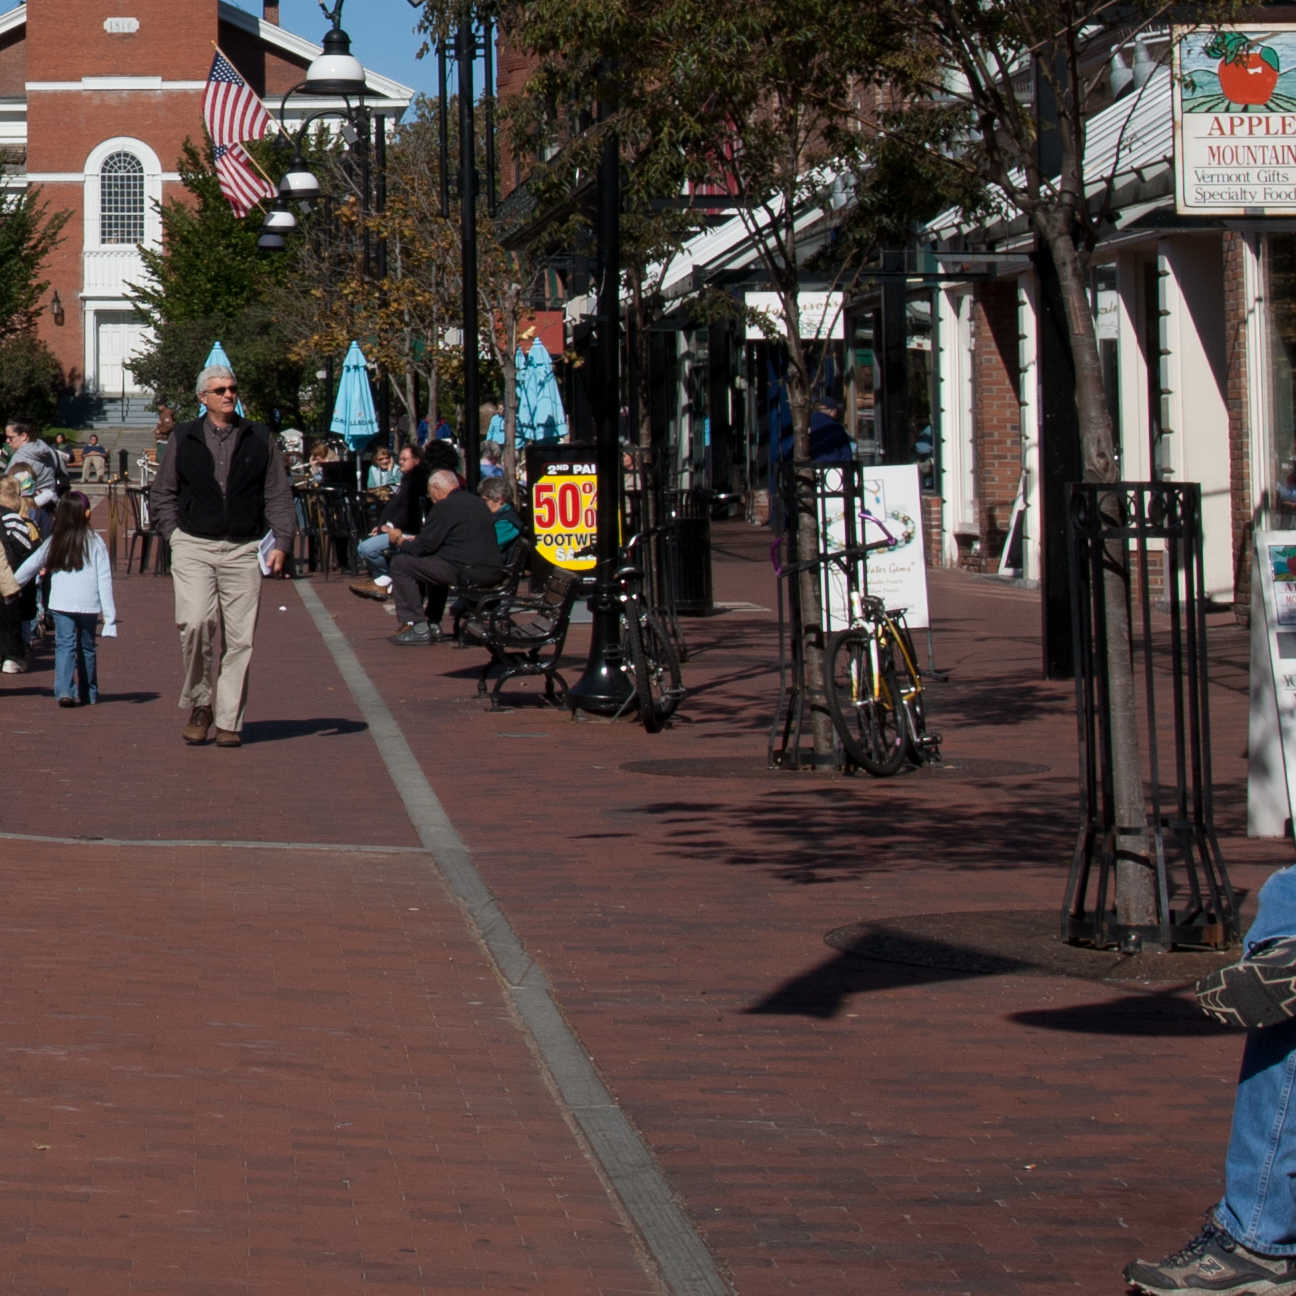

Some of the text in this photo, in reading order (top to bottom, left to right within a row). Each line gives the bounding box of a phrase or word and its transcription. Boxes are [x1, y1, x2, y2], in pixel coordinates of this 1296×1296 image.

[1207, 115, 1296, 136] APPLE
[1207, 145, 1296, 165] MOUNTAIN
[1194, 169, 1289, 183] Vermont Gifts
[1195, 187, 1257, 203] Specialty
[547, 464, 597, 475] 2ND PAI
[532, 482, 597, 530] 50%
[535, 533, 597, 546] FOOTWE
[555, 547, 597, 562] SA
